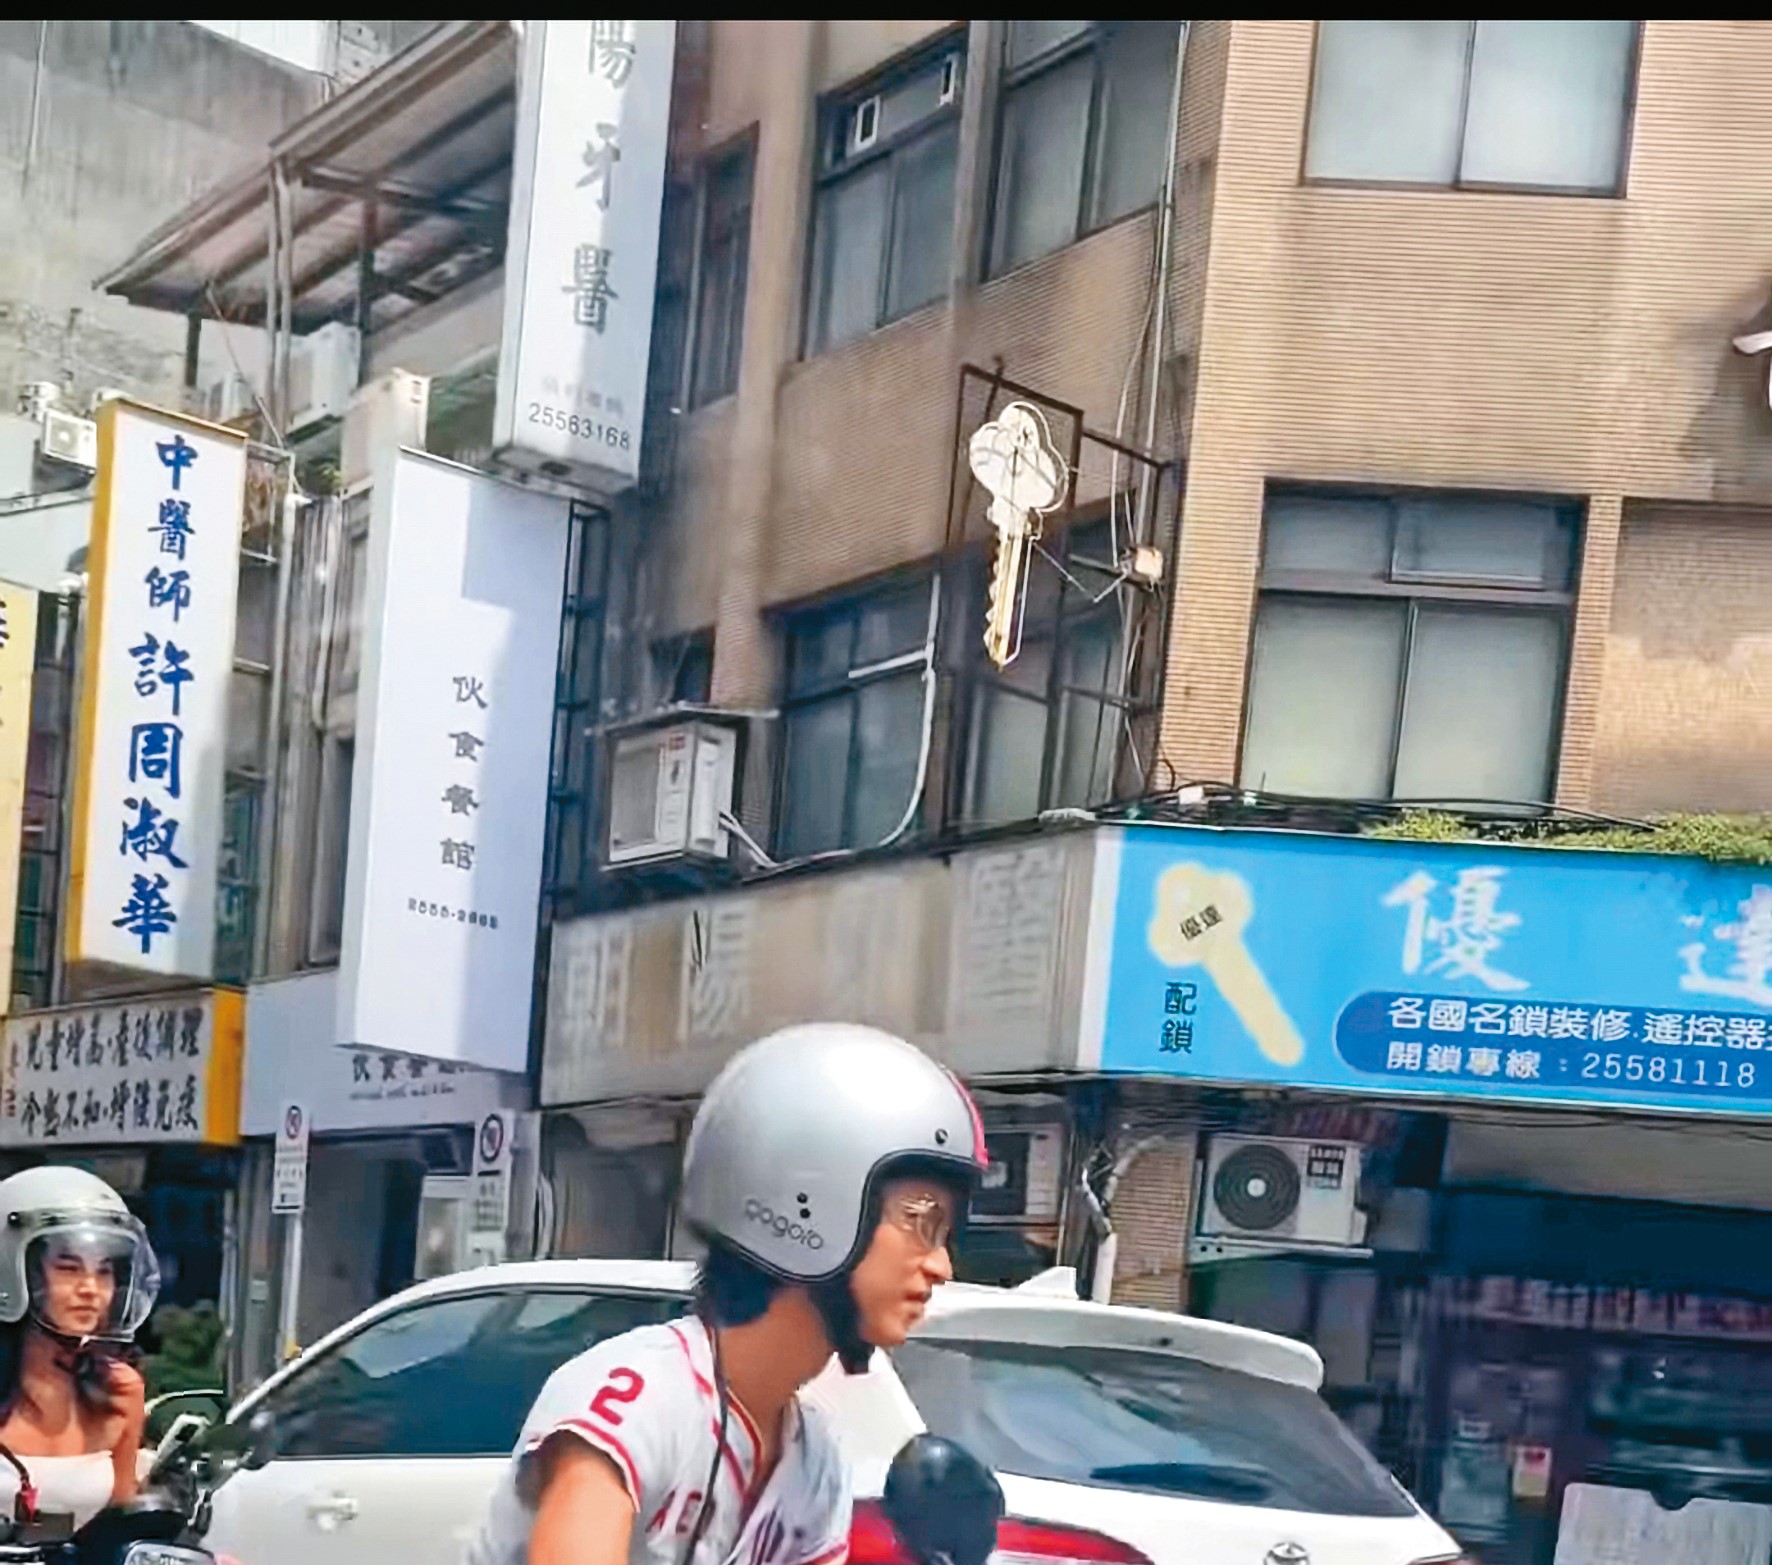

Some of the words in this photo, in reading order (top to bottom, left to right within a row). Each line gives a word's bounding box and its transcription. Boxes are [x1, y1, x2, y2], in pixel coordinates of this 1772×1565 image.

[528, 402, 631, 451] 25563168
[112, 434, 197, 955] 中醫師許周淑華
[440, 676, 488, 870] 伙食餐館
[1158, 981, 1198, 1055] 配鎖
[588, 1367, 645, 1427] 2
